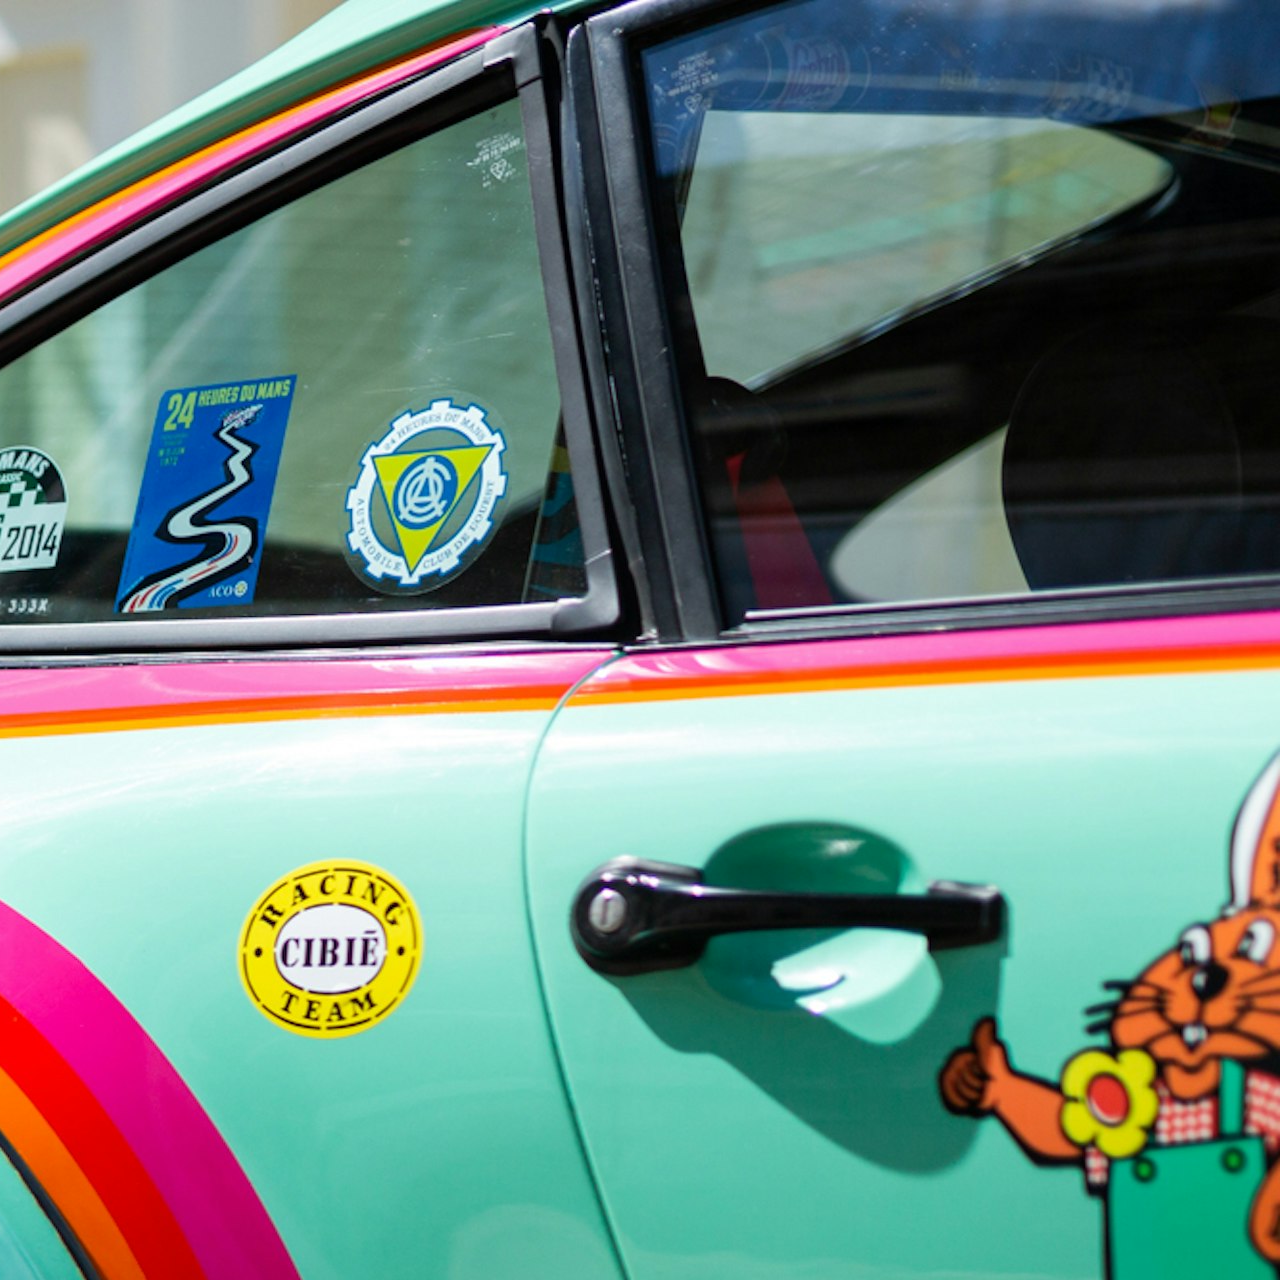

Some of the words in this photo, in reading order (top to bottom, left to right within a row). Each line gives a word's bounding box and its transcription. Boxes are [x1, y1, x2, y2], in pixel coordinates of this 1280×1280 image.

[163, 391, 198, 432] 24
[198, 386, 240, 407] HEURES
[239, 384, 257, 402] DU
[256, 379, 291, 400] MANS
[397, 411, 442, 440] HEURES
[444, 412, 461, 423] DU
[461, 417, 487, 442] MANS
[1, 521, 58, 561] 2014
[356, 496, 403, 571] AUTOMOBILE
[422, 548, 454, 571] CLUB
[455, 533, 472, 551] DE
[208, 583, 233, 598] ACO
[259, 873, 405, 930] RACING
[280, 989, 378, 1023] TEAM
